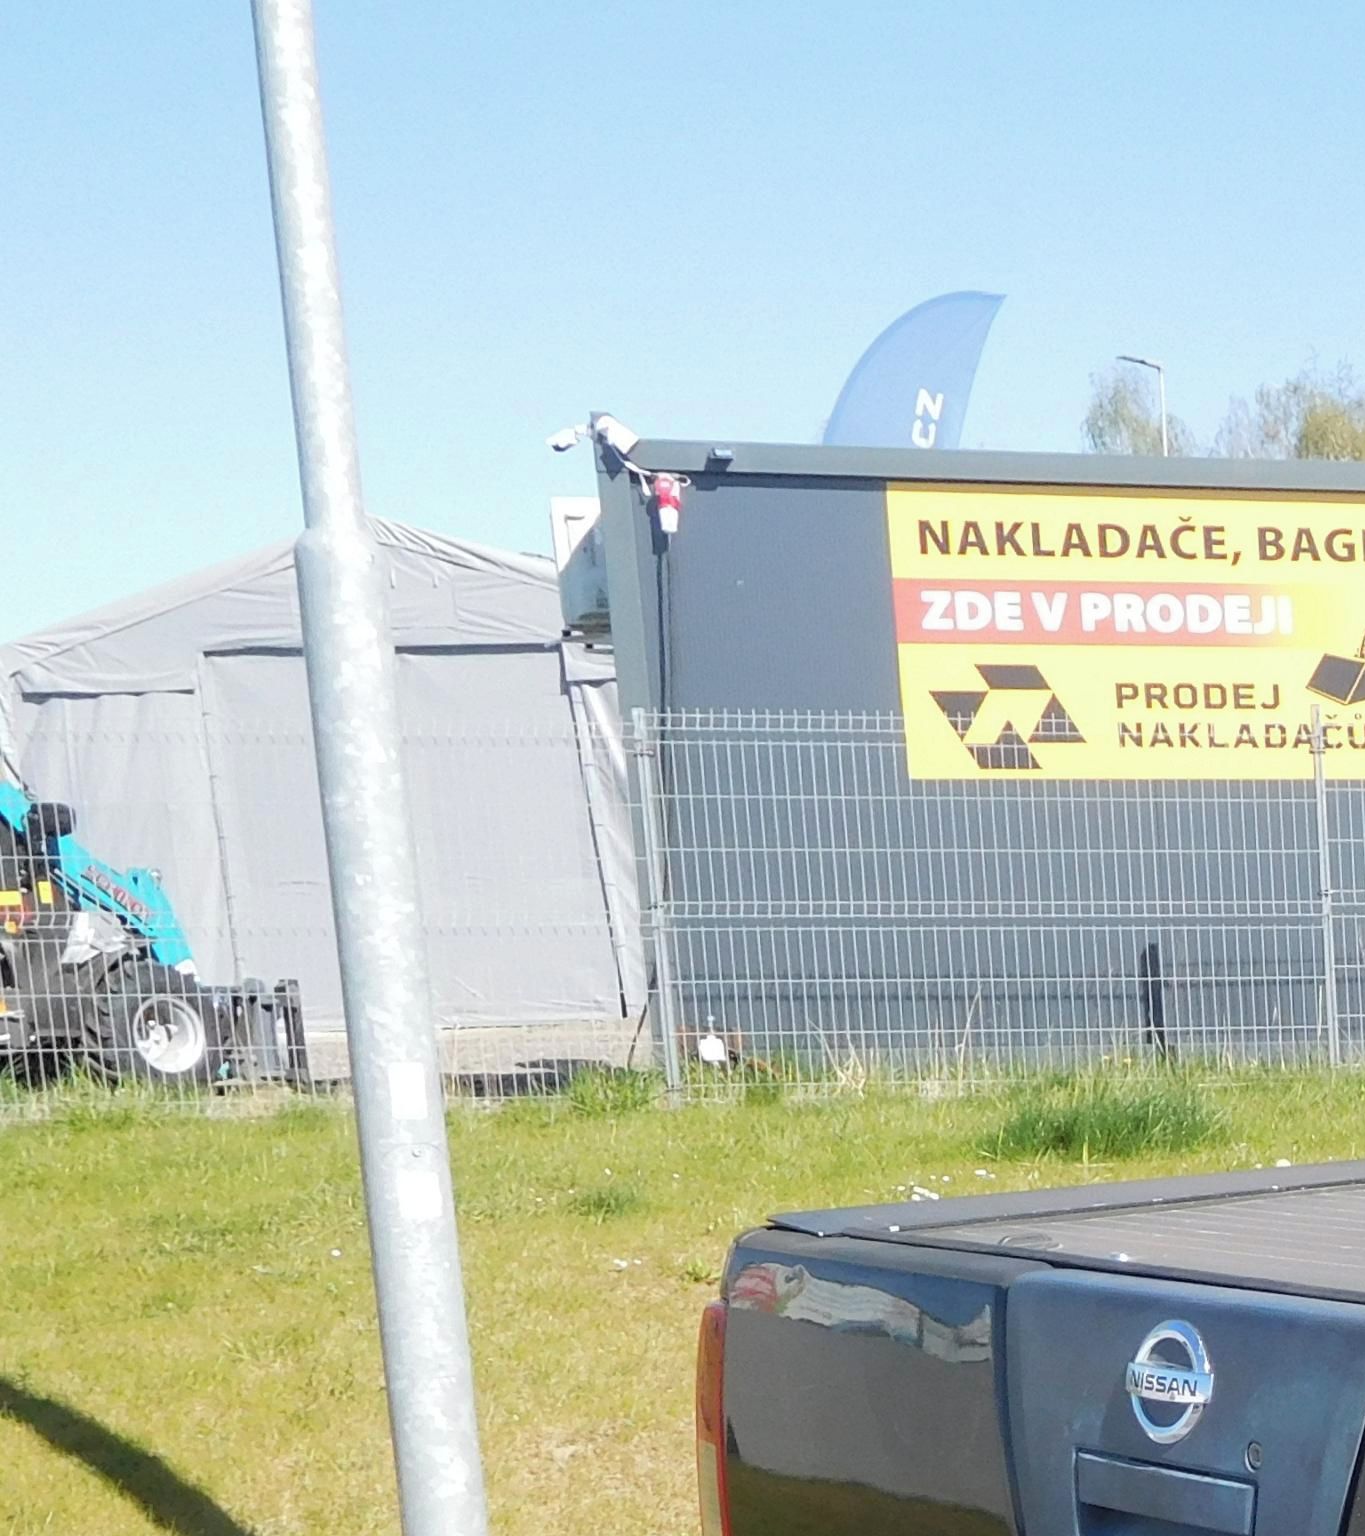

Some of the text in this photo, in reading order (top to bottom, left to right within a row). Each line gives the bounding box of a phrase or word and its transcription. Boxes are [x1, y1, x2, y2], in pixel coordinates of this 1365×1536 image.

[917, 516, 1242, 566] NAKLADAČE,
[920, 589, 1294, 635] ZDE V PRODEJI
[1115, 682, 1280, 710] PRODEJ
[1130, 1370, 1198, 1398] NISSAN
